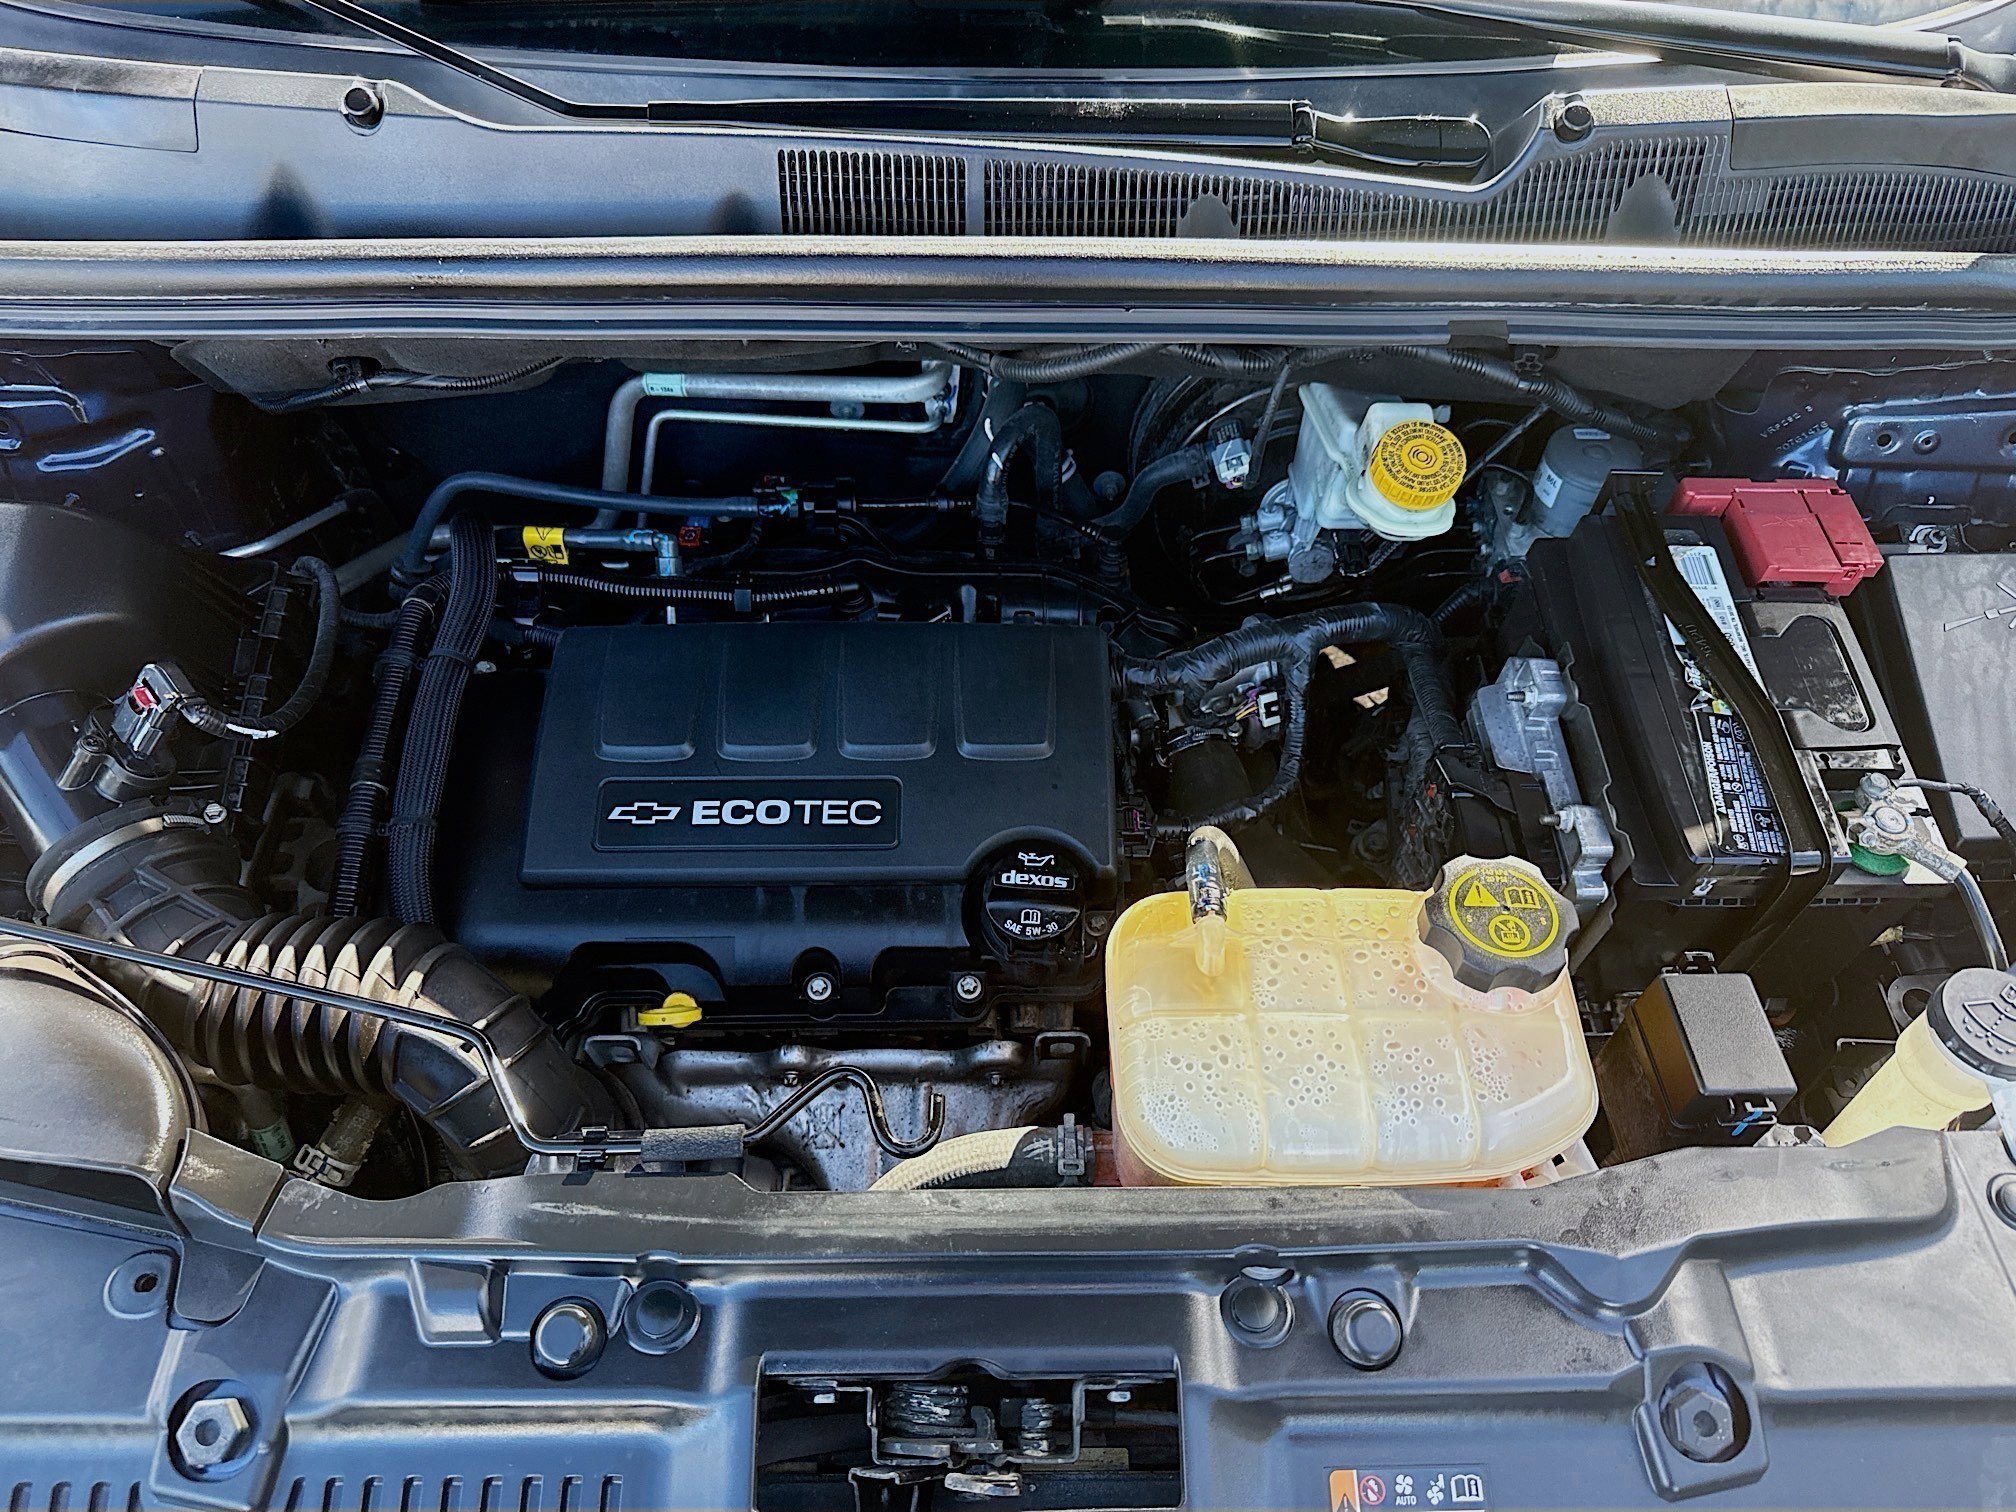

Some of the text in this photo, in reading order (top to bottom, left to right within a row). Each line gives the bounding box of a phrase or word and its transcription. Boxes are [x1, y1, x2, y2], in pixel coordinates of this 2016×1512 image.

[691, 799, 882, 825] ECOTEC
[1001, 869, 1070, 888] dexos
[1004, 920, 1058, 936] SAE 5W-30
[1396, 1496, 1416, 1506] AUTO
